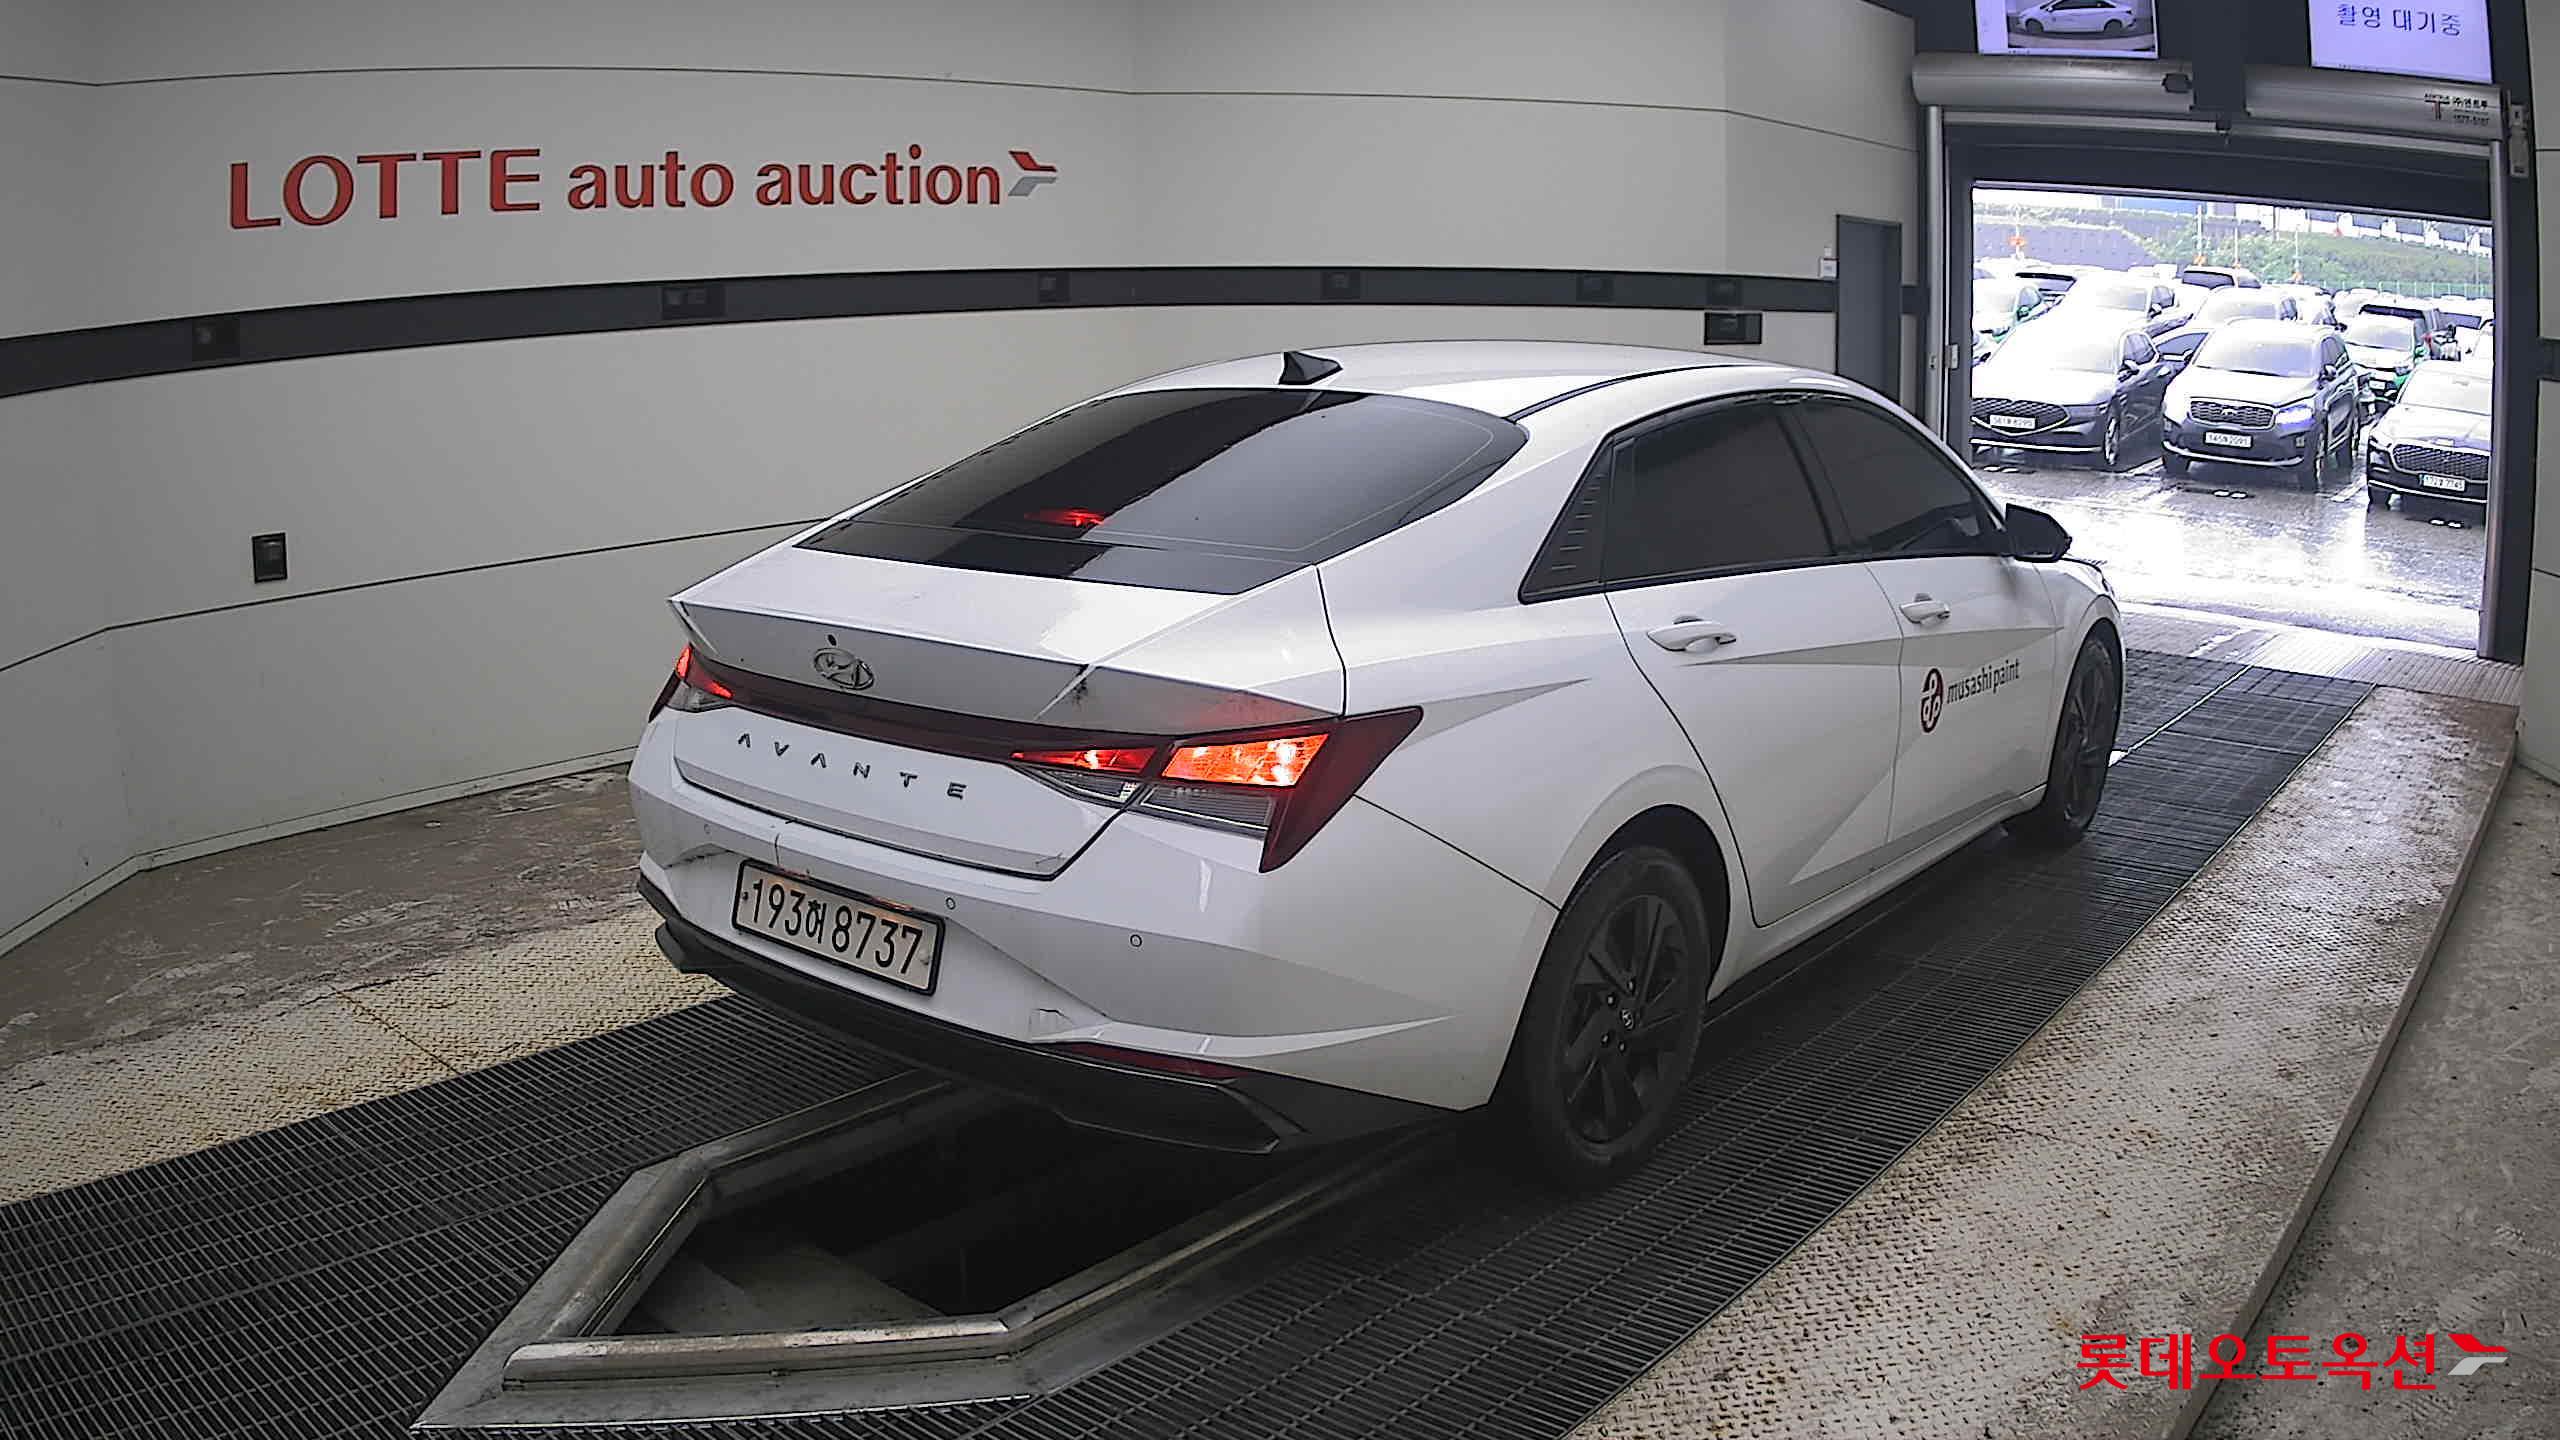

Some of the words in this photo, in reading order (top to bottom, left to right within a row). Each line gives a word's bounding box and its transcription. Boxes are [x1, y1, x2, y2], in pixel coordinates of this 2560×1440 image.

[2337, 4, 2381, 28] 촬영
[2392, 9, 2460, 36] 대기중
[230, 148, 541, 230] LOTTE
[567, 151, 735, 209] auto
[756, 143, 1001, 206] auction
[737, 732, 967, 800] AVANTE
[752, 879, 923, 974] 193허8737
